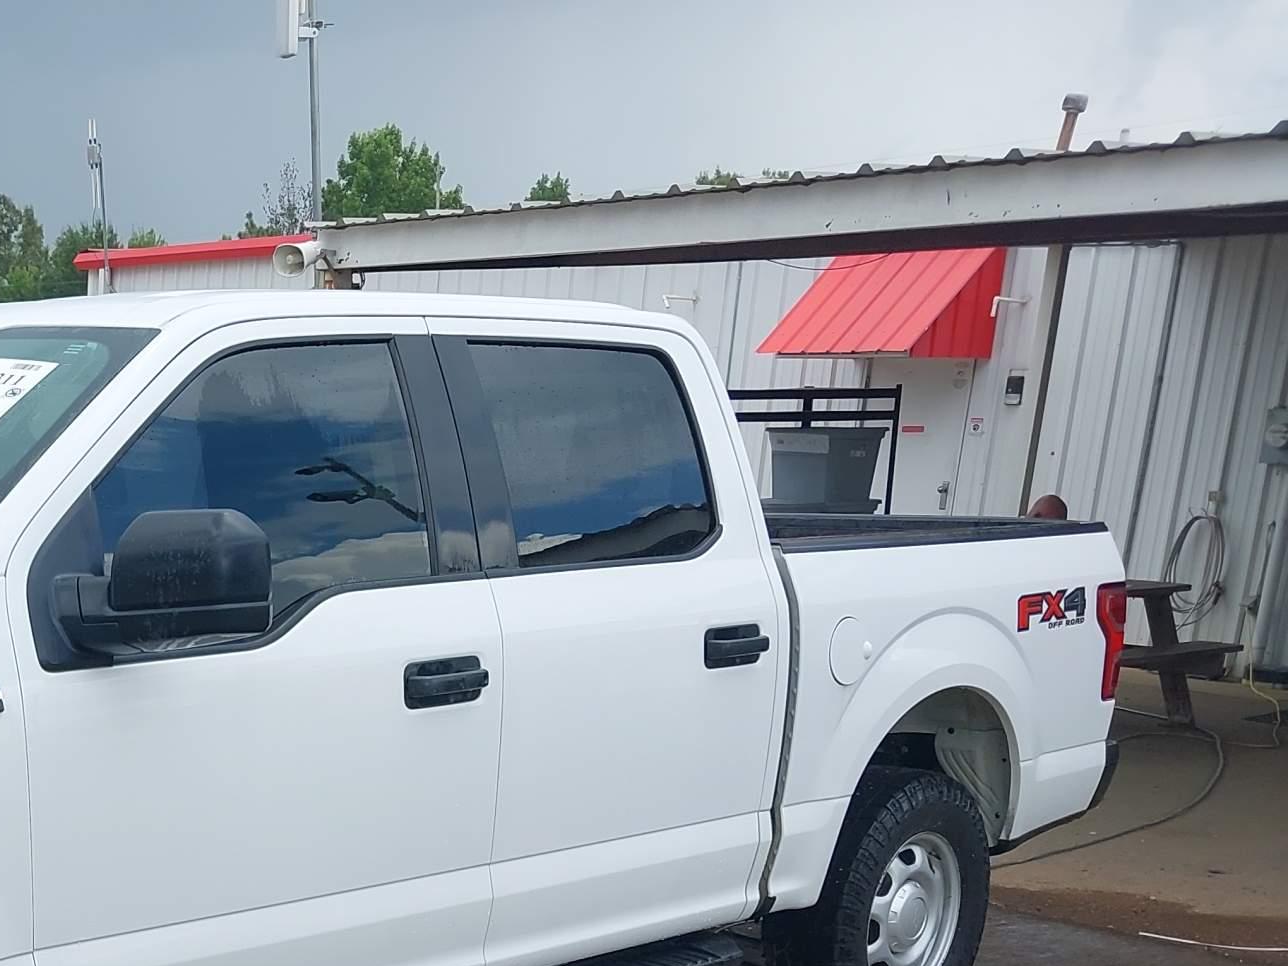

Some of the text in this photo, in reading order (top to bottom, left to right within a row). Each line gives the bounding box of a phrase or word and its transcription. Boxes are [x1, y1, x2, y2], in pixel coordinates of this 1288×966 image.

[1017, 586, 1086, 632] FX4
[1048, 617, 1085, 630] OFF ROAD
